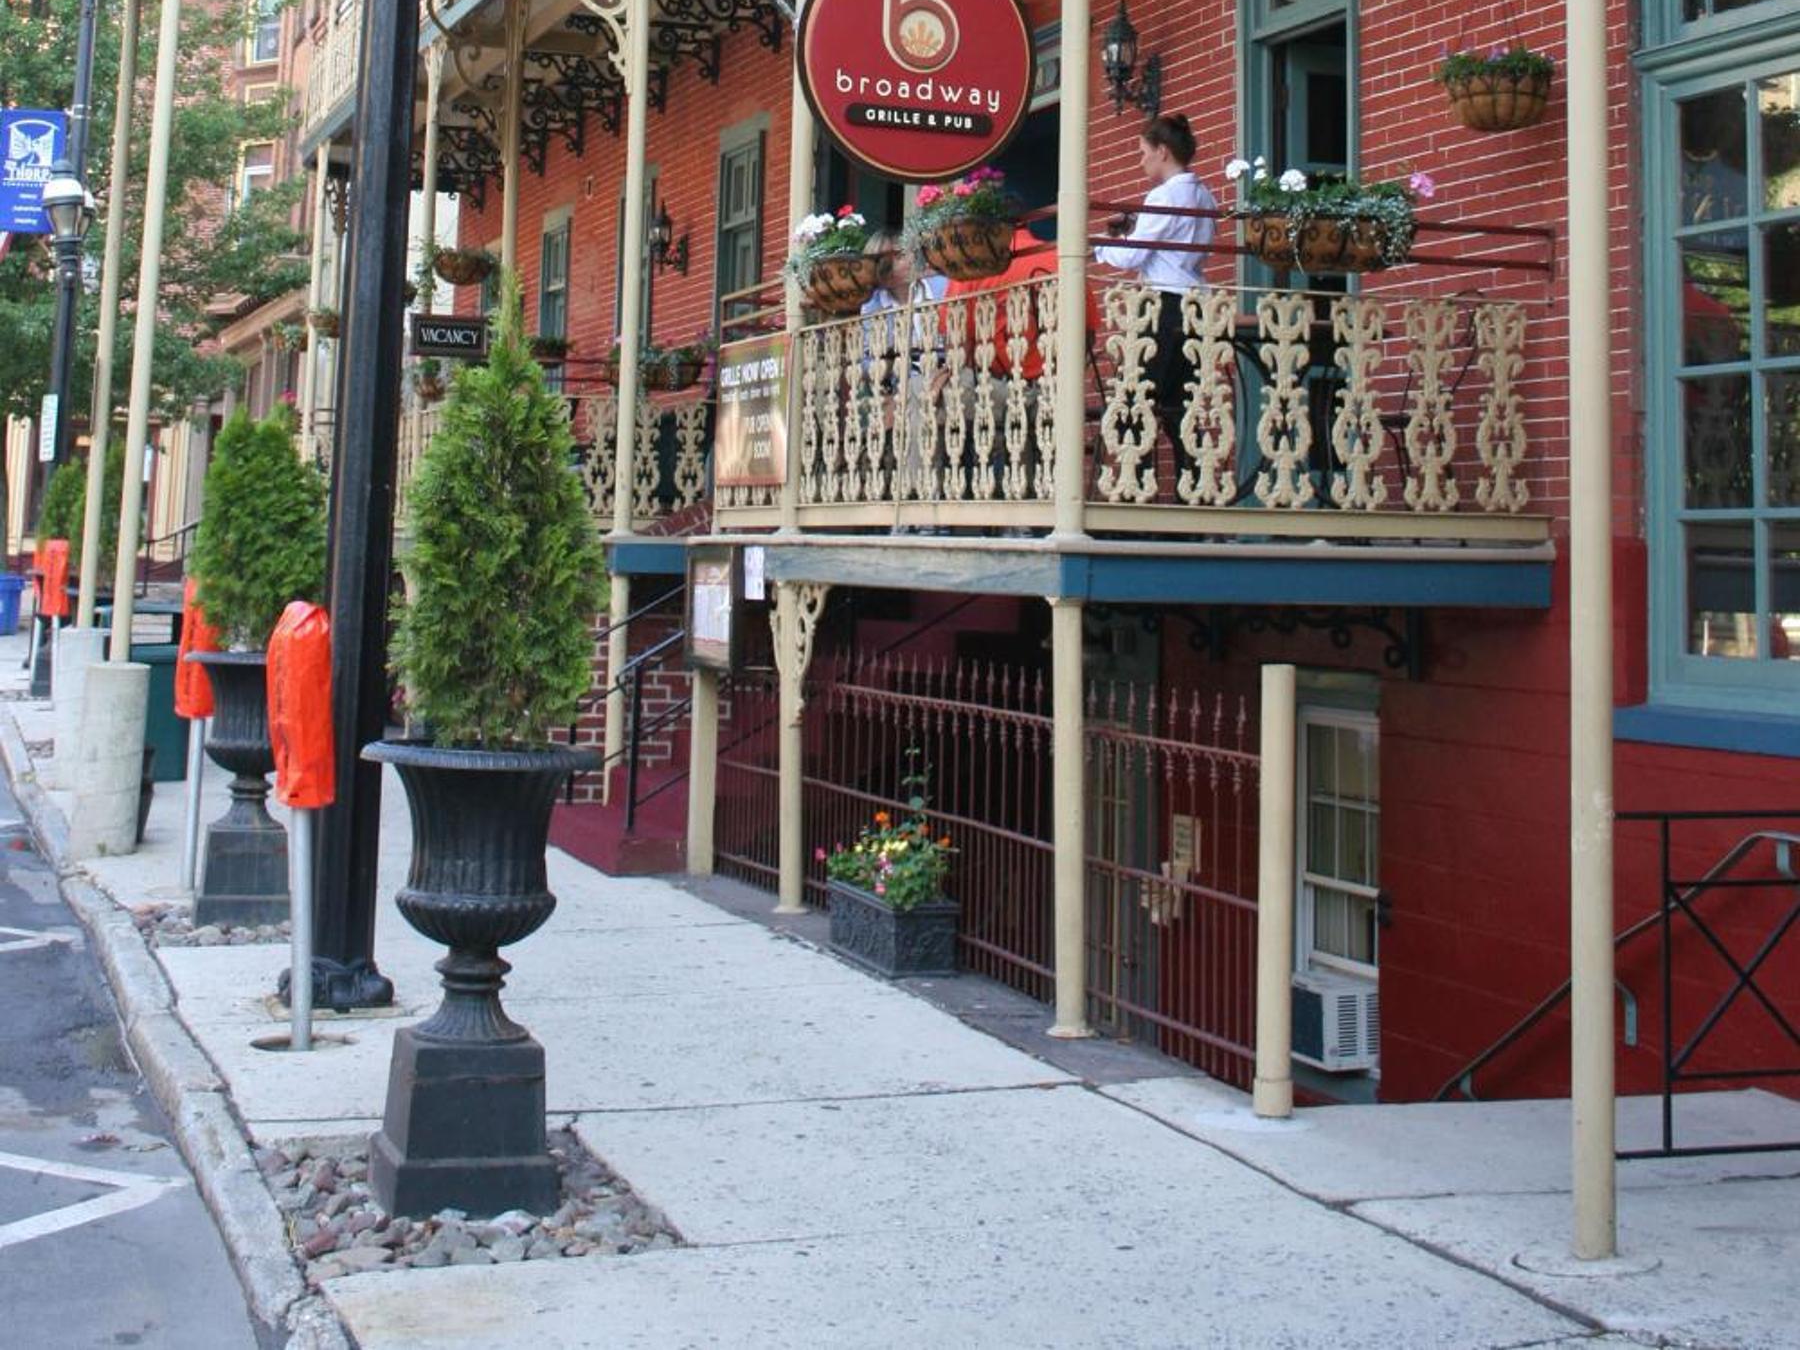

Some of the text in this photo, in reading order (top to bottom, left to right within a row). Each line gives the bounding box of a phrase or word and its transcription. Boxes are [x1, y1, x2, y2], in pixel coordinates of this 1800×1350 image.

[836, 69, 1000, 112] broadway
[865, 109, 973, 129] GRILLE & PUB
[420, 328, 478, 345] VACANCY
[741, 360, 760, 383] NOW
[760, 356, 779, 381] OPEN
